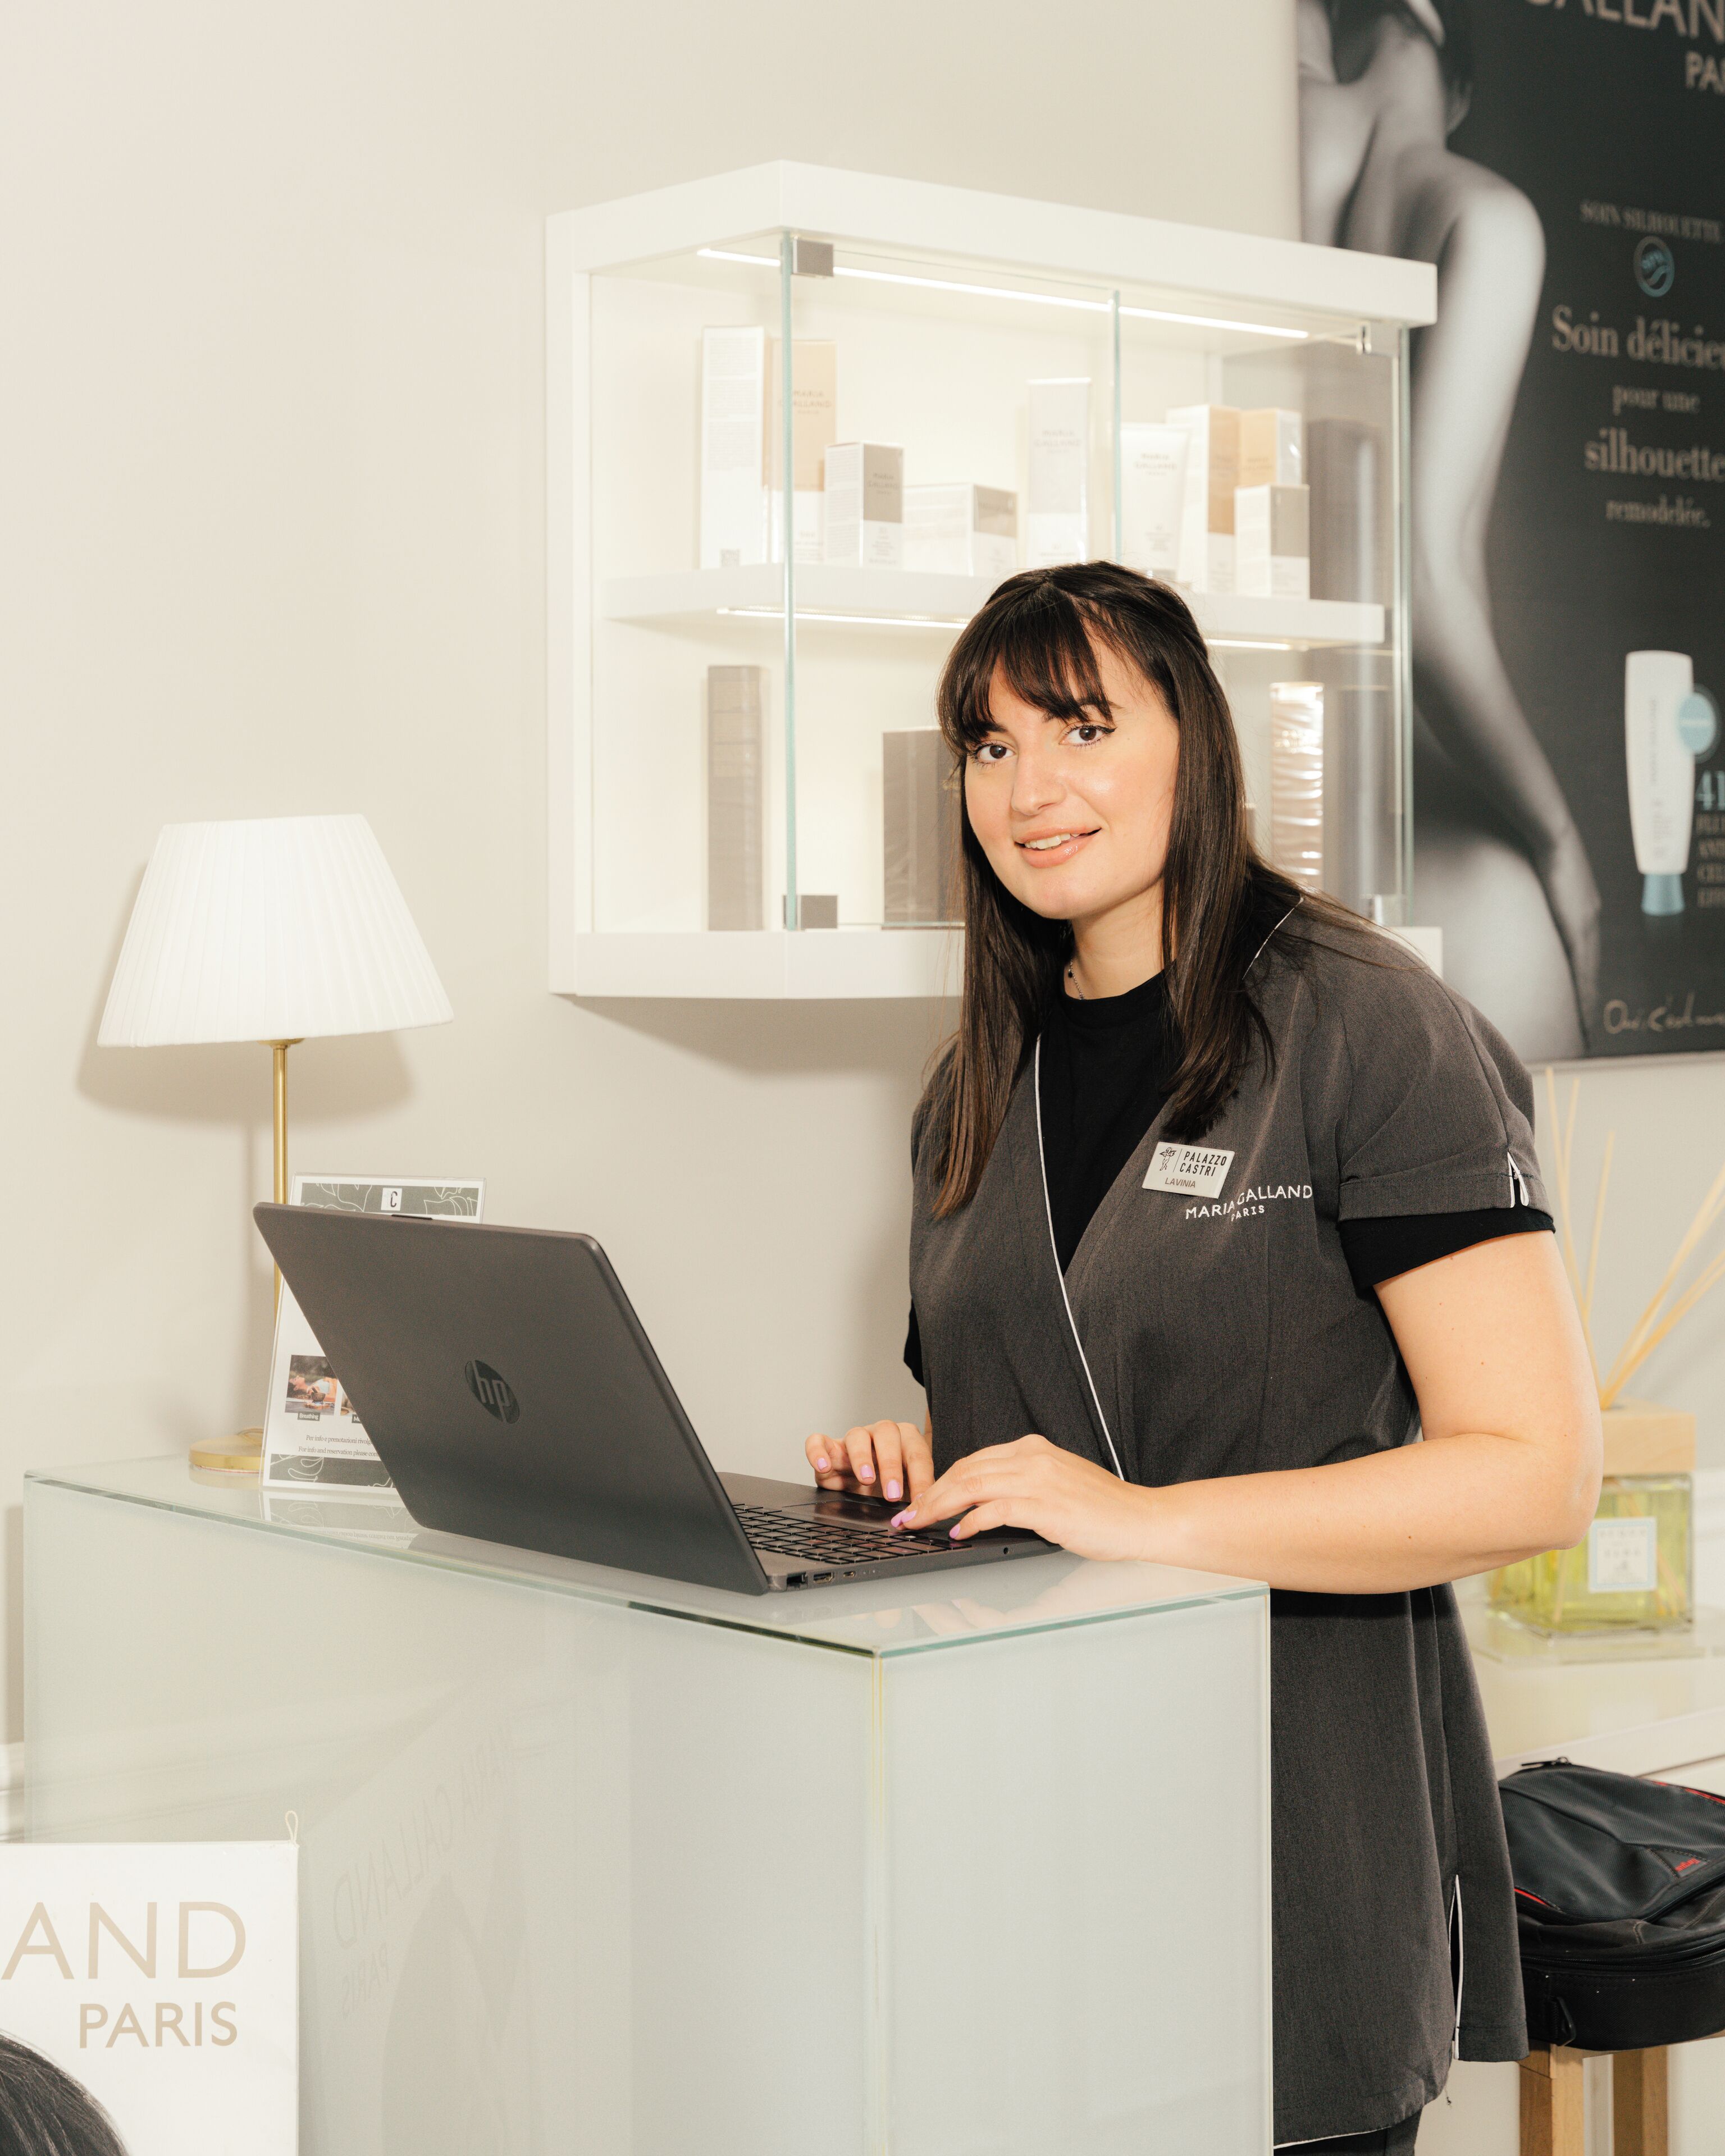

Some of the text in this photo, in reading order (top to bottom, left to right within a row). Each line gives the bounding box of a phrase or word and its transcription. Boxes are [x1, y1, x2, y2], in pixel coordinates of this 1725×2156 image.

[1553, 305, 1725, 371] Soin délicie
[1612, 385, 1701, 415] pour une
[1585, 428, 1725, 483] silhouette
[1180, 1163, 1216, 1177] CASTRI
[1184, 1151, 1227, 1166] PALAZZO
[1165, 1177, 1196, 1188] LAVINIA
[1185, 1185, 1313, 1219] MARIA GALLAND
[1231, 1205, 1265, 1221] PARIS
[472, 1360, 510, 1422] hp
[79, 2002, 238, 2048] PARIS
